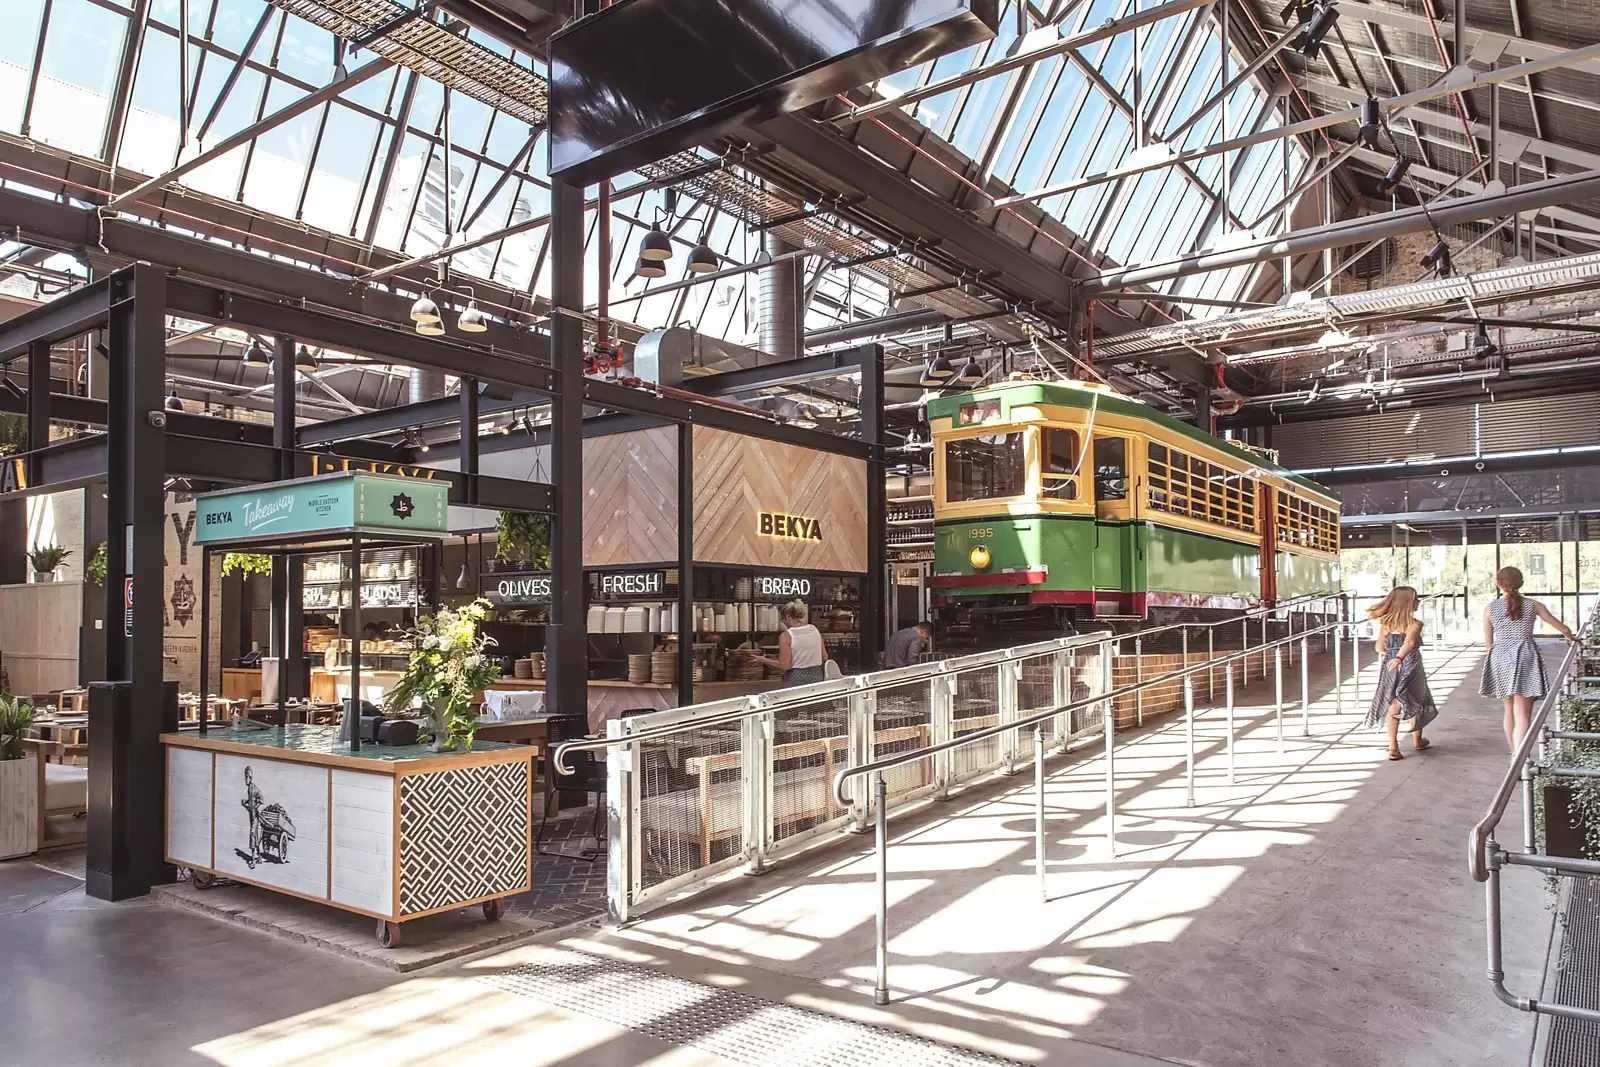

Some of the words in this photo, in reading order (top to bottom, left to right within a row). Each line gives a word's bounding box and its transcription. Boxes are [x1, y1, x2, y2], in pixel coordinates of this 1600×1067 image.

[242, 494, 296, 527] Takeaway
[308, 499, 322, 507] MIDDLE
[323, 497, 339, 505] EASTERN
[206, 511, 233, 525] BEKYA
[760, 513, 823, 540] BEKYA
[968, 527, 993, 539] 1995
[498, 578, 551, 597] OLIVES
[602, 574, 658, 594] FRESH
[762, 577, 811, 595] BREAD
